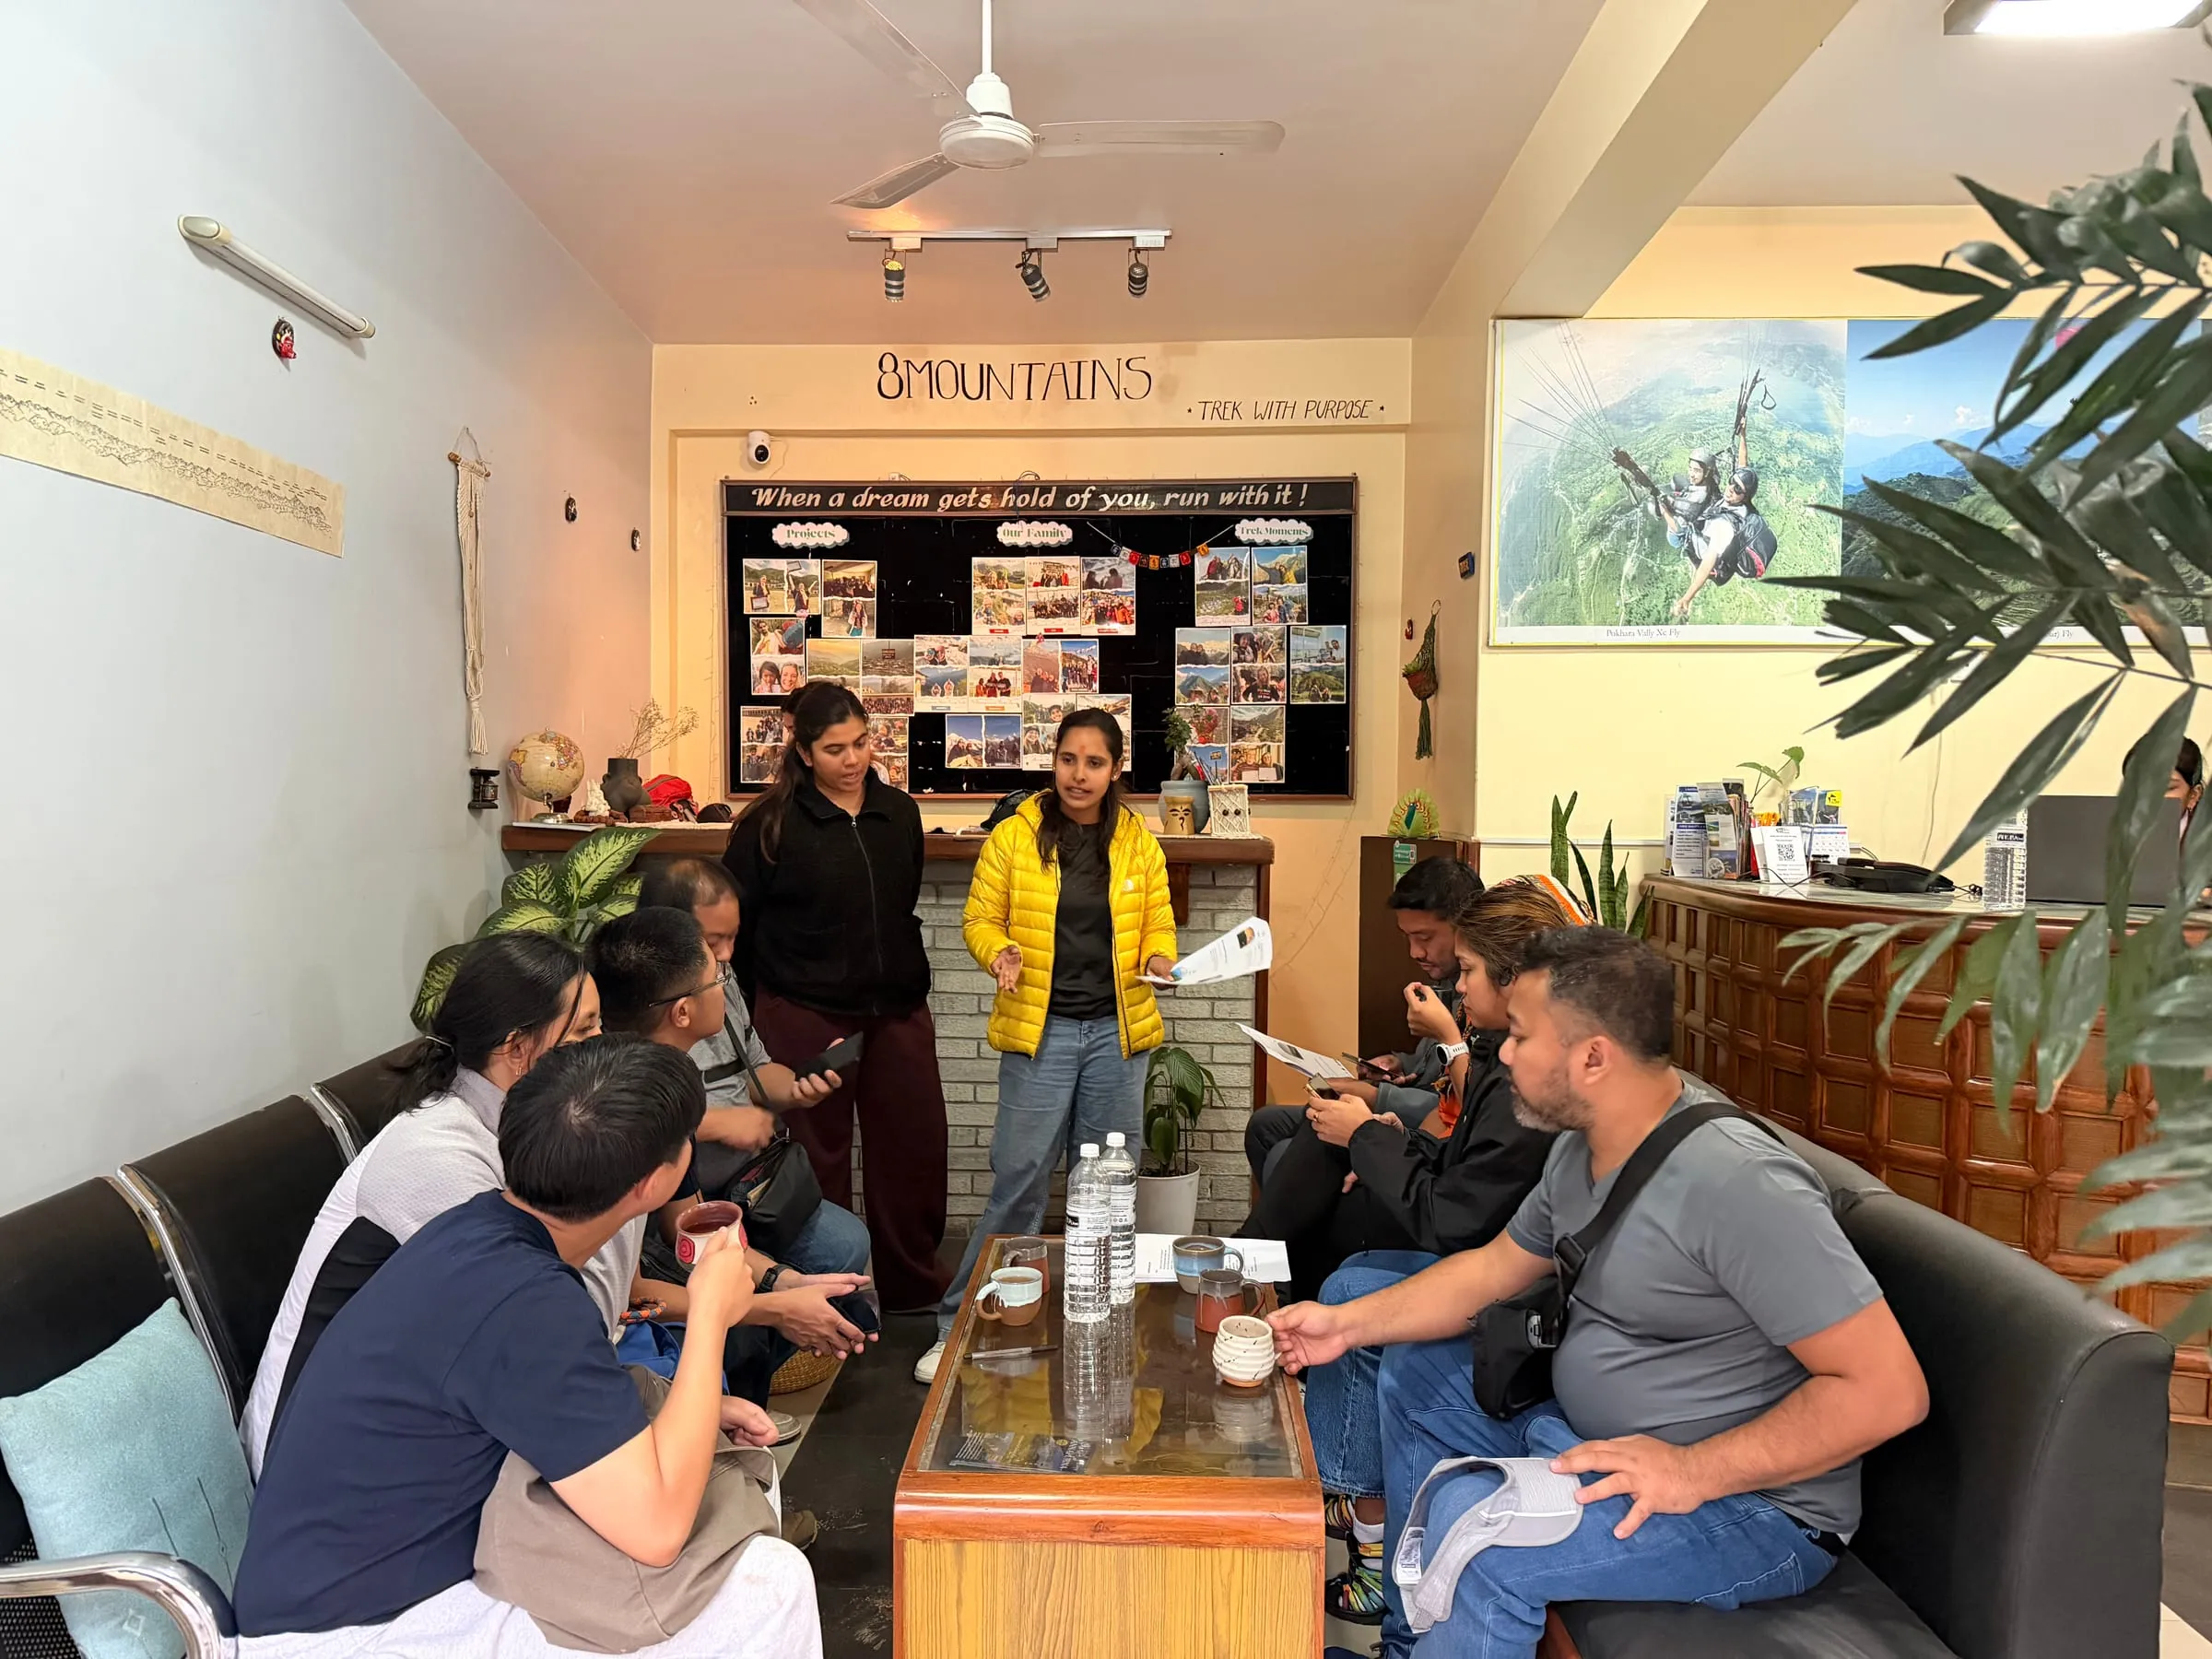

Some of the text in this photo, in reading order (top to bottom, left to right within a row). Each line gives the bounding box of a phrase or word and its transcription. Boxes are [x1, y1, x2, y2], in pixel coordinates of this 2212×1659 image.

[877, 352, 1152, 401] 8MOUNTAINS
[1197, 399, 1374, 420] TREK WITH PURPOSE
[751, 487, 820, 508] When
[828, 492, 845, 508] a
[852, 486, 930, 508] dream
[936, 487, 993, 512] gets
[999, 486, 1057, 507] hold
[1065, 485, 1097, 512] of
[1098, 492, 1156, 512] you,
[1163, 491, 1210, 507] run
[1218, 484, 1268, 506] with
[786, 527, 836, 540] Projects
[1002, 527, 1066, 538] Our Family
[1264, 526, 1309, 535] Moments
